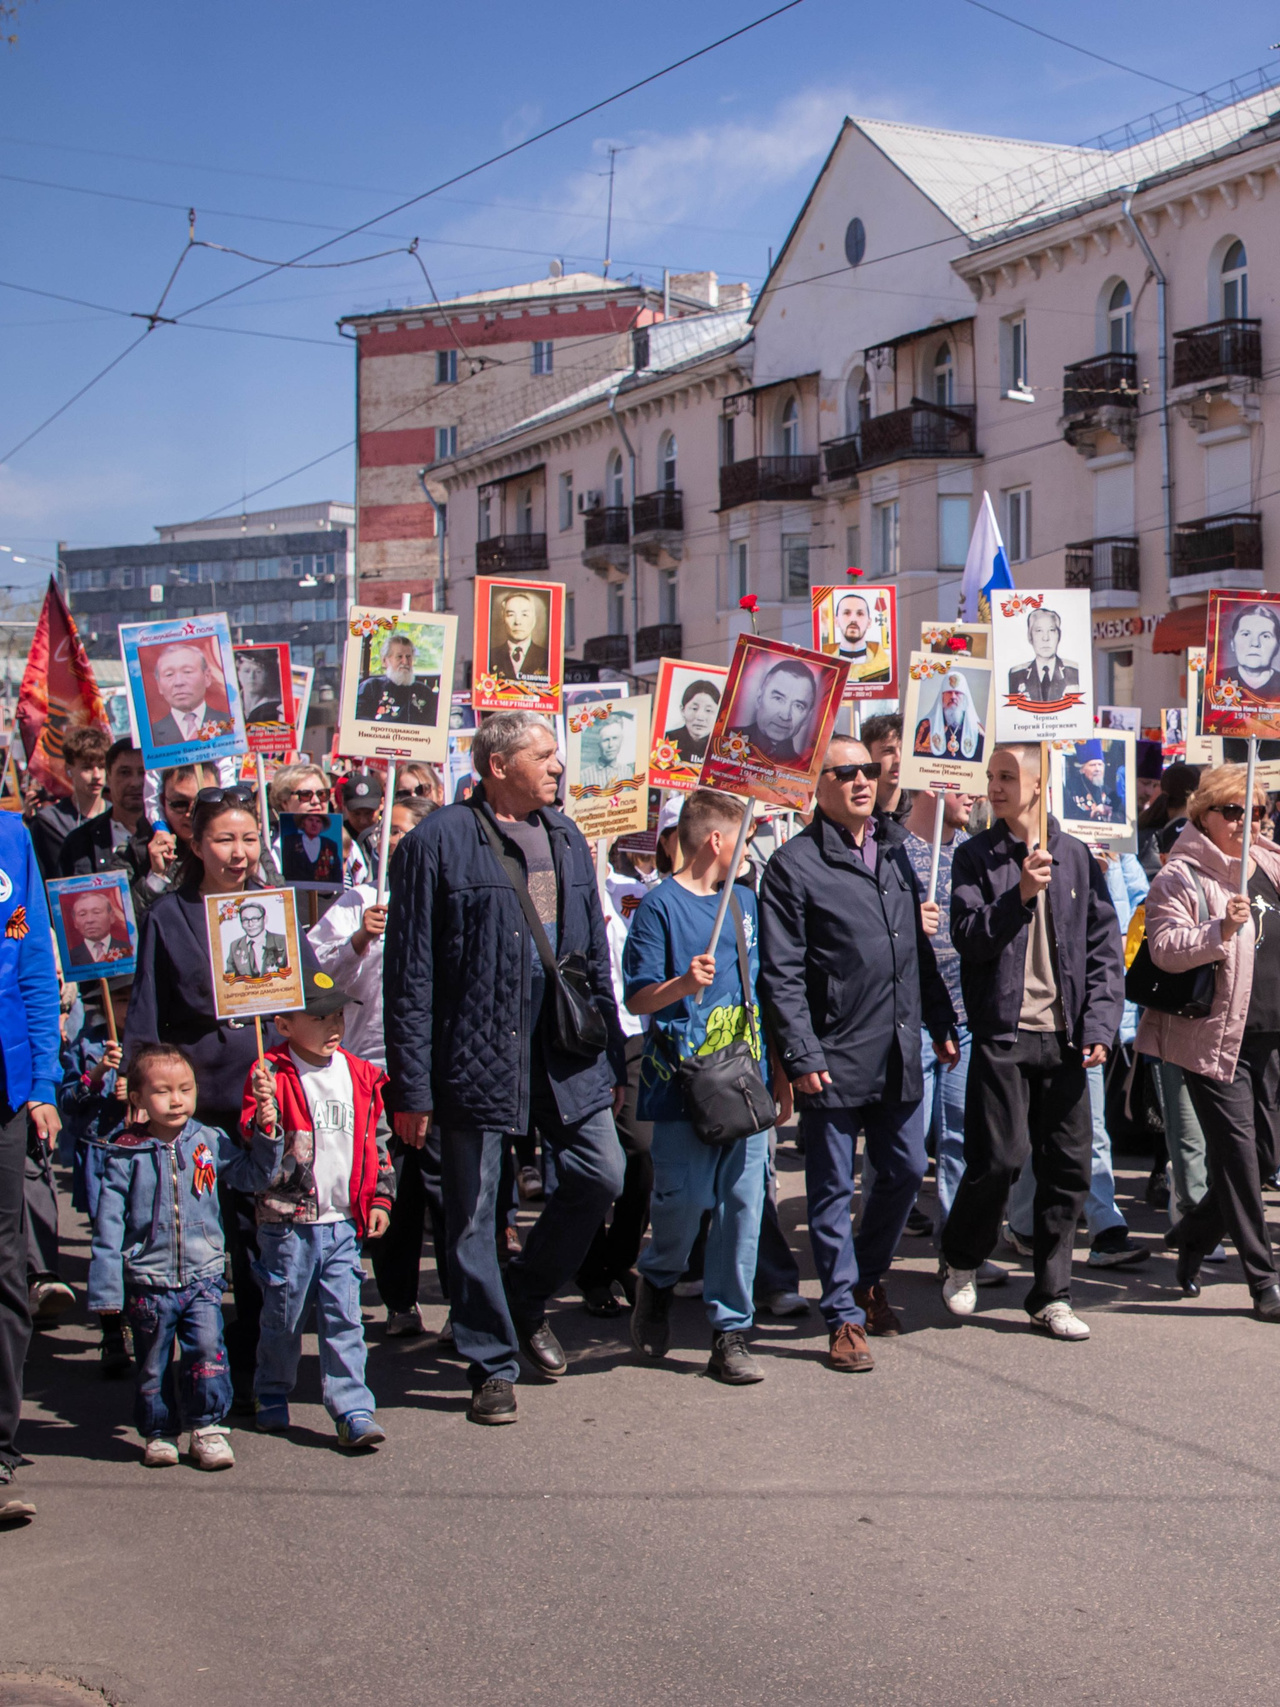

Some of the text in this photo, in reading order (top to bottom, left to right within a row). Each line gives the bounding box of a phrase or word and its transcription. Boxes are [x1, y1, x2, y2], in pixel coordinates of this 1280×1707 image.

[481, 699, 534, 708] БЕССМЕРТНЫЙ
[1013, 722, 1078, 731] Георгий Георгиевич
[358, 731, 431, 745] Николай (Попович)
[741, 761, 775, 776] Александр
